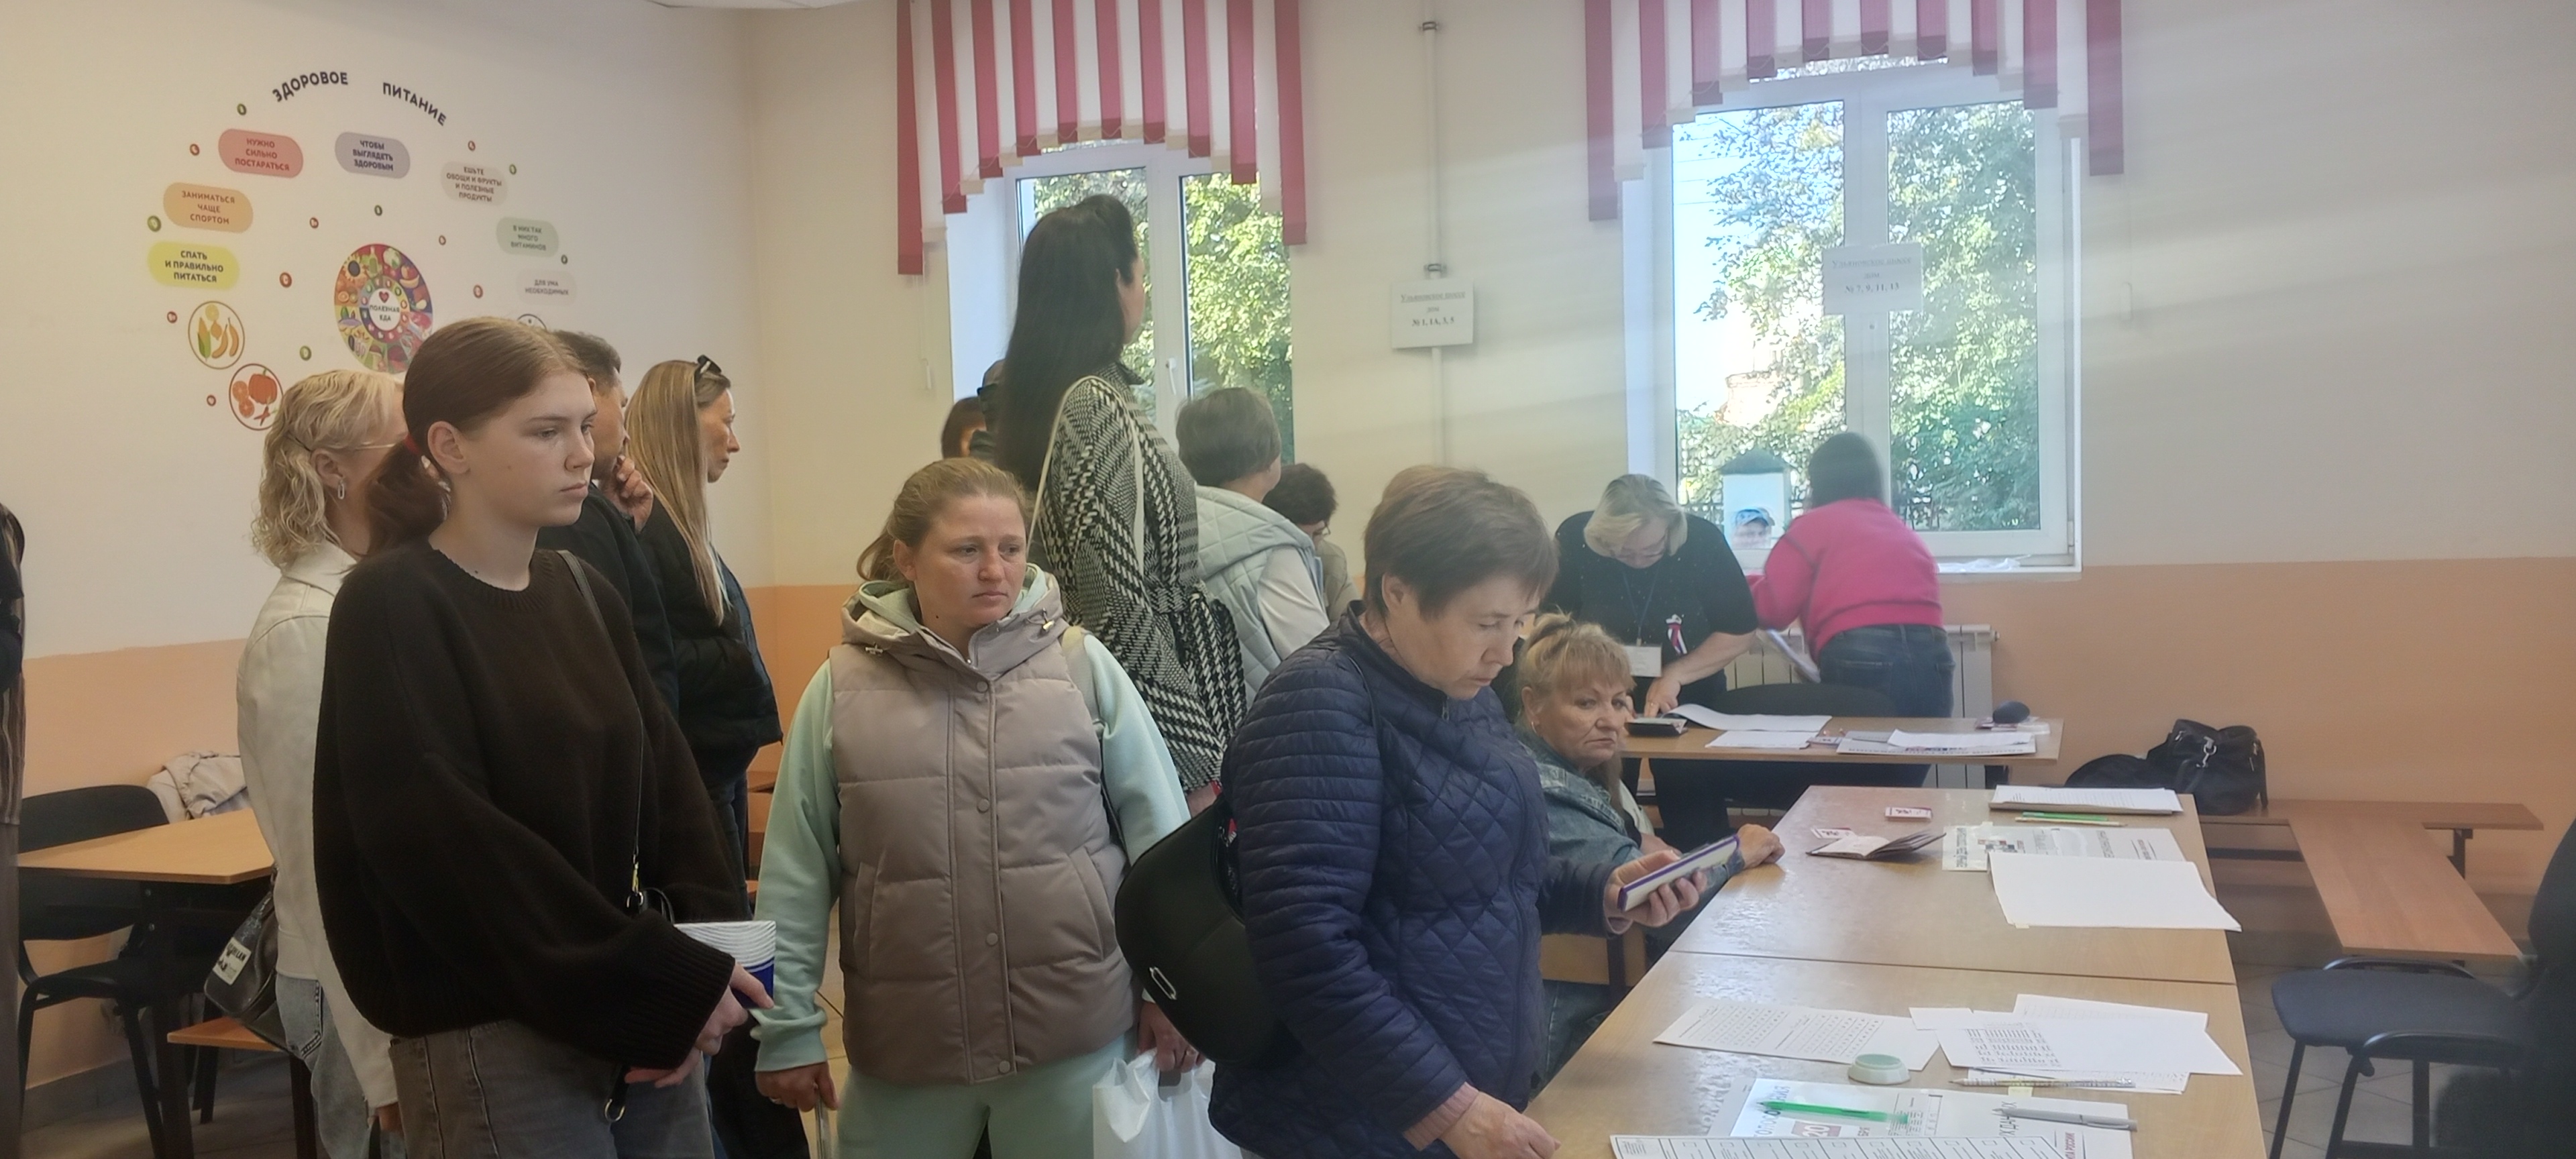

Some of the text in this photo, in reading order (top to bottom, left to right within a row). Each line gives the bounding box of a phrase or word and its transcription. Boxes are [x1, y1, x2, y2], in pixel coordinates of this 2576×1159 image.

[272, 71, 447, 126] ЗДОРОВОЕ ПИТАНИЕ
[246, 137, 276, 149] НУЖНО
[360, 140, 385, 151] ЧТОБЫ
[246, 148, 278, 160] СИЛЬНО
[352, 148, 394, 162] ВЫГЛЯДЕТЬ
[235, 158, 290, 171] ПОСТАРАТЬСЯ
[354, 159, 394, 172] ЗДОРОВЫМ
[464, 166, 484, 176] ЕШЬТЕ
[446, 172, 470, 182] ОВОЩИ
[477, 176, 502, 186] ФРУКТЫ
[461, 183, 494, 195] ПОЛЕЗНЫЕ
[181, 190, 235, 204] ЗАНИМАТЬСЯ
[458, 192, 492, 203] ПРОДУКТЫ
[197, 203, 220, 213] ЧАЩЕ
[190, 213, 229, 225] СПОРТОМ
[518, 234, 539, 242] МНОГО
[511, 241, 547, 252] ВИТАМИНОВ
[180, 250, 207, 260] СПАТЬ
[172, 260, 224, 272] ПРАВИЛЬНО
[1832, 259, 1884, 268] Ульяновское
[173, 272, 217, 282] ПИТАТЬСЯ
[525, 287, 569, 296] НЕОБХОДИМЫХ
[1845, 282, 1900, 293] № 7, 9, 11, 13
[369, 305, 400, 313] ПОЛЕЗНАЯ
[1802, 1125, 1831, 1137] 20
